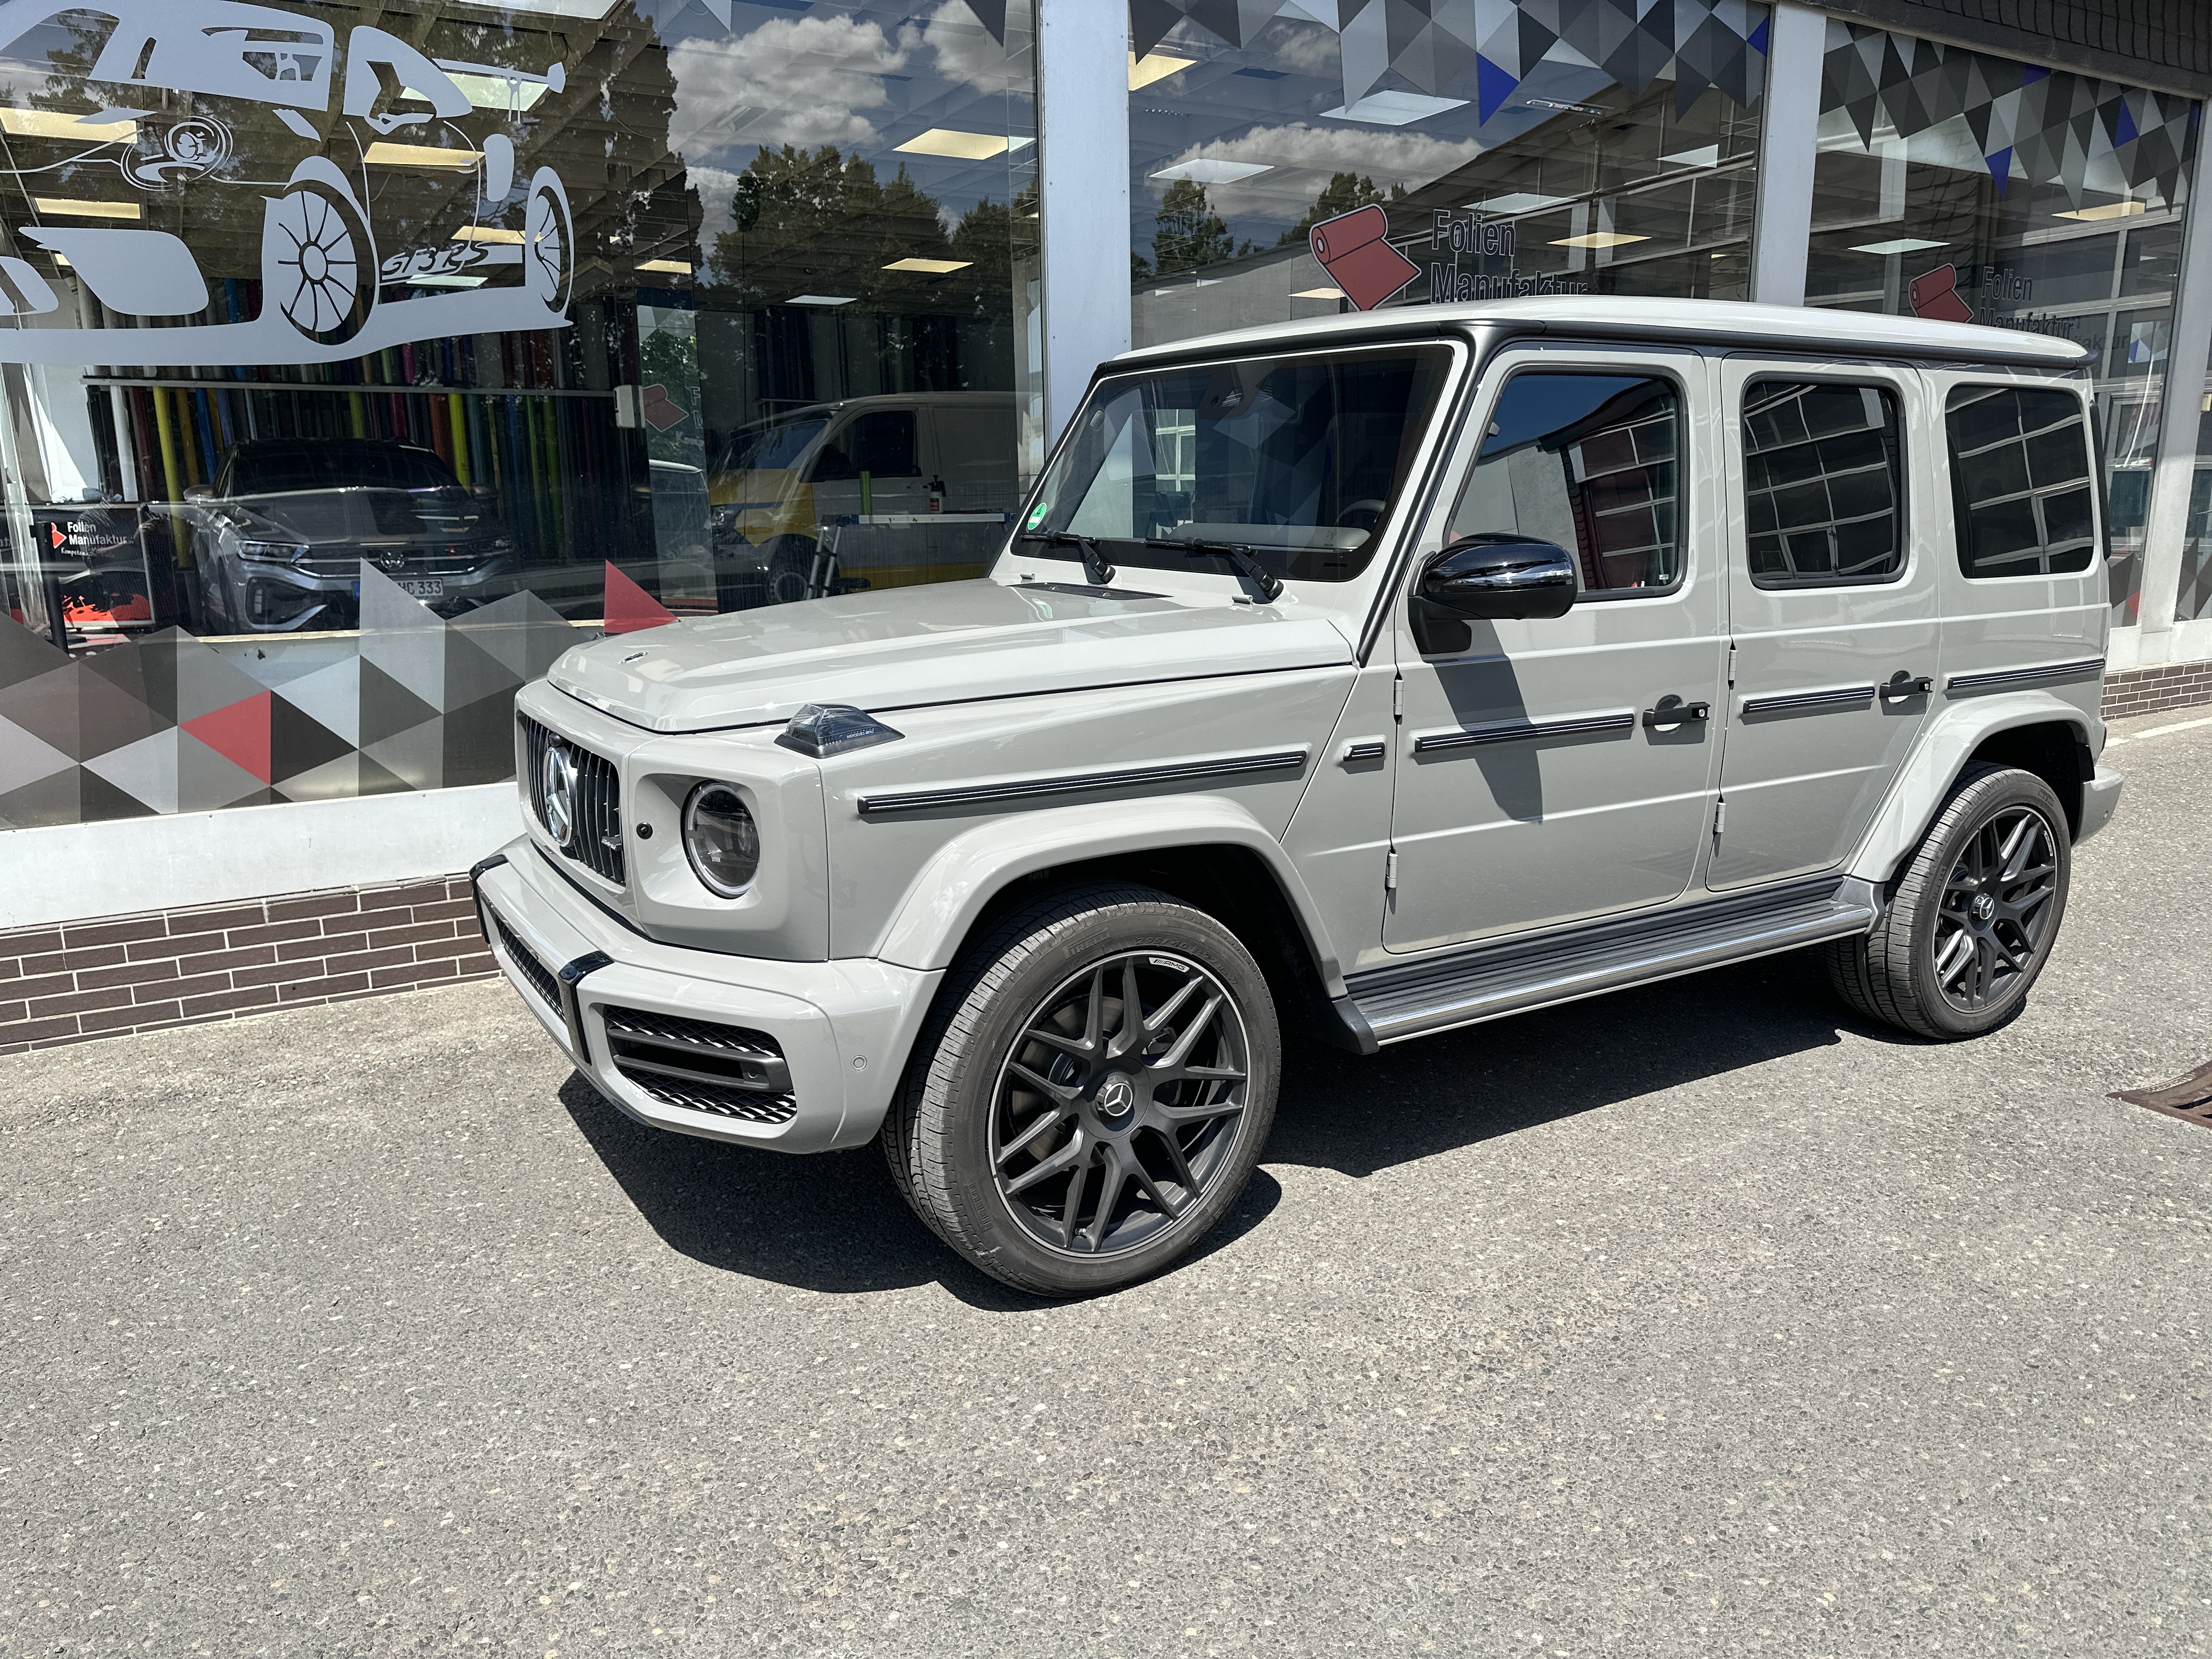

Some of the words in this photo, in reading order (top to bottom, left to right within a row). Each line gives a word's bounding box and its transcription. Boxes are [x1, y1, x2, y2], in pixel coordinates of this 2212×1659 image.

[1432, 209, 1516, 257] Folien
[1981, 266, 2033, 302] Folien
[67, 521, 96, 533] Folien
[417, 582, 441, 594] 333
